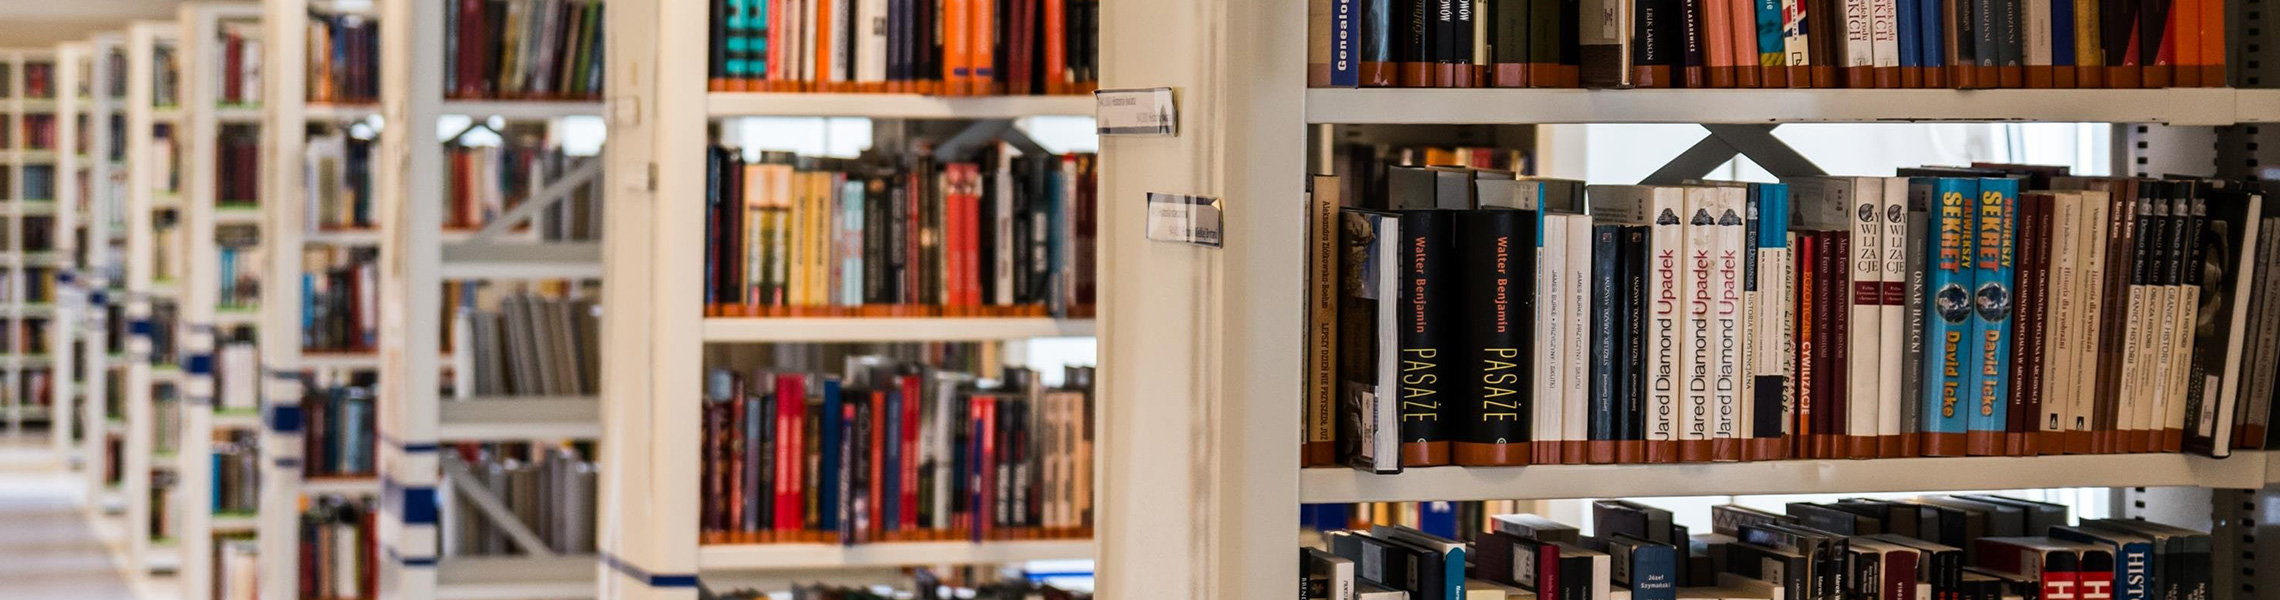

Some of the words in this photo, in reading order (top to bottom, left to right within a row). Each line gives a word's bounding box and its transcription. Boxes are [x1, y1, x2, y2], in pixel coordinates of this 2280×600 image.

[1646, 29, 1655, 61] LARSON
[1860, 224, 1877, 235] WI
[2114, 201, 2123, 221] Marcin
[2127, 201, 2137, 221] Marcin
[1822, 237, 1831, 255] Marc
[1840, 238, 1848, 255] Marc
[1863, 237, 1876, 247] LI
[1889, 225, 1905, 236] WI
[1892, 237, 1903, 248] LI
[1939, 191, 1963, 273] SEKRET
[1961, 198, 1974, 269] NAJWIĘKSZY
[1979, 191, 2002, 273] SEKRET
[2000, 197, 2014, 268] NAJWIĘKSZY
[2138, 219, 2149, 249] DONALD
[2155, 219, 2166, 249] DONALD
[2172, 219, 2184, 249] DONALD
[2193, 219, 2204, 249] DONALD
[1416, 237, 1427, 274] Walter
[1497, 237, 1508, 274] Walter
[1821, 256, 1830, 274] Ferro
[1839, 256, 1847, 274] Ferro
[1857, 261, 1879, 273] CJE
[1860, 248, 1877, 260] ZA
[1886, 261, 1905, 273] CJE
[1889, 249, 1904, 260] ZA
[2135, 260, 2145, 283] KELLEY
[2152, 260, 2161, 283] KELLEY
[2169, 260, 2179, 284] KELLEY
[2189, 260, 2198, 283] KELLEY
[1657, 249, 1677, 315] Upadek
[1692, 249, 1711, 315] Upadek
[1719, 249, 1739, 315] Upadek
[1913, 271, 1924, 305] OSKAR
[2020, 270, 2030, 322] DOKUMENTACJA
[2037, 269, 2047, 321] DOKUMENTACJA
[2061, 267, 2072, 298] Historia
[2089, 270, 2100, 301] Historia
[1413, 278, 1427, 333] Benjamin
[1494, 278, 1508, 333] Benjamin
[1746, 293, 1755, 328] HISTORIA
[1802, 271, 1813, 340] EGZOTYCZNE
[2061, 298, 2070, 310] dla
[2089, 301, 2098, 313] dla
[2129, 287, 2142, 325] GRANICE
[2147, 287, 2158, 317] OBLICZA
[2163, 287, 2177, 325] GRANICE
[2184, 287, 2195, 317] OBLICZA
[1549, 322, 1557, 359] PRZYCZYNY
[1575, 323, 1583, 361] PRZYCZYNY
[1911, 308, 1922, 354] HALECKI
[2018, 322, 2028, 356] SPECJALNA
[2035, 321, 2045, 356] SPECJALNA
[2058, 311, 2069, 350] wyobraźni
[2086, 314, 2097, 353] wyobraźni
[2127, 327, 2138, 364] HISTORII
[2145, 318, 2155, 349] HISTORII
[2160, 327, 2172, 364] HISTORII
[2181, 318, 2192, 349] HISTORII
[1656, 319, 1673, 391] Diamond
[1691, 319, 1708, 391] Diamond
[1717, 319, 1735, 391] Diamond
[1744, 329, 1753, 390] EGZYSTENCJALNA
[1944, 331, 1961, 377] David
[1983, 329, 2001, 375] David
[1320, 372, 1329, 386] NIE
[1403, 348, 1442, 422] PASAŻE
[1483, 348, 1522, 422] PASAŻE
[1800, 341, 1812, 416] CYWILIZACJE
[2015, 364, 2025, 405] ARCHIWACH
[2031, 363, 2042, 404] ARCHIWACH
[1942, 380, 1959, 418] Icke
[1981, 379, 1998, 417] Icke
[1655, 395, 1670, 441] Jared
[1690, 395, 1706, 441] Jared
[1716, 395, 1733, 440] Jared
[2127, 551, 2146, 600] HIST
